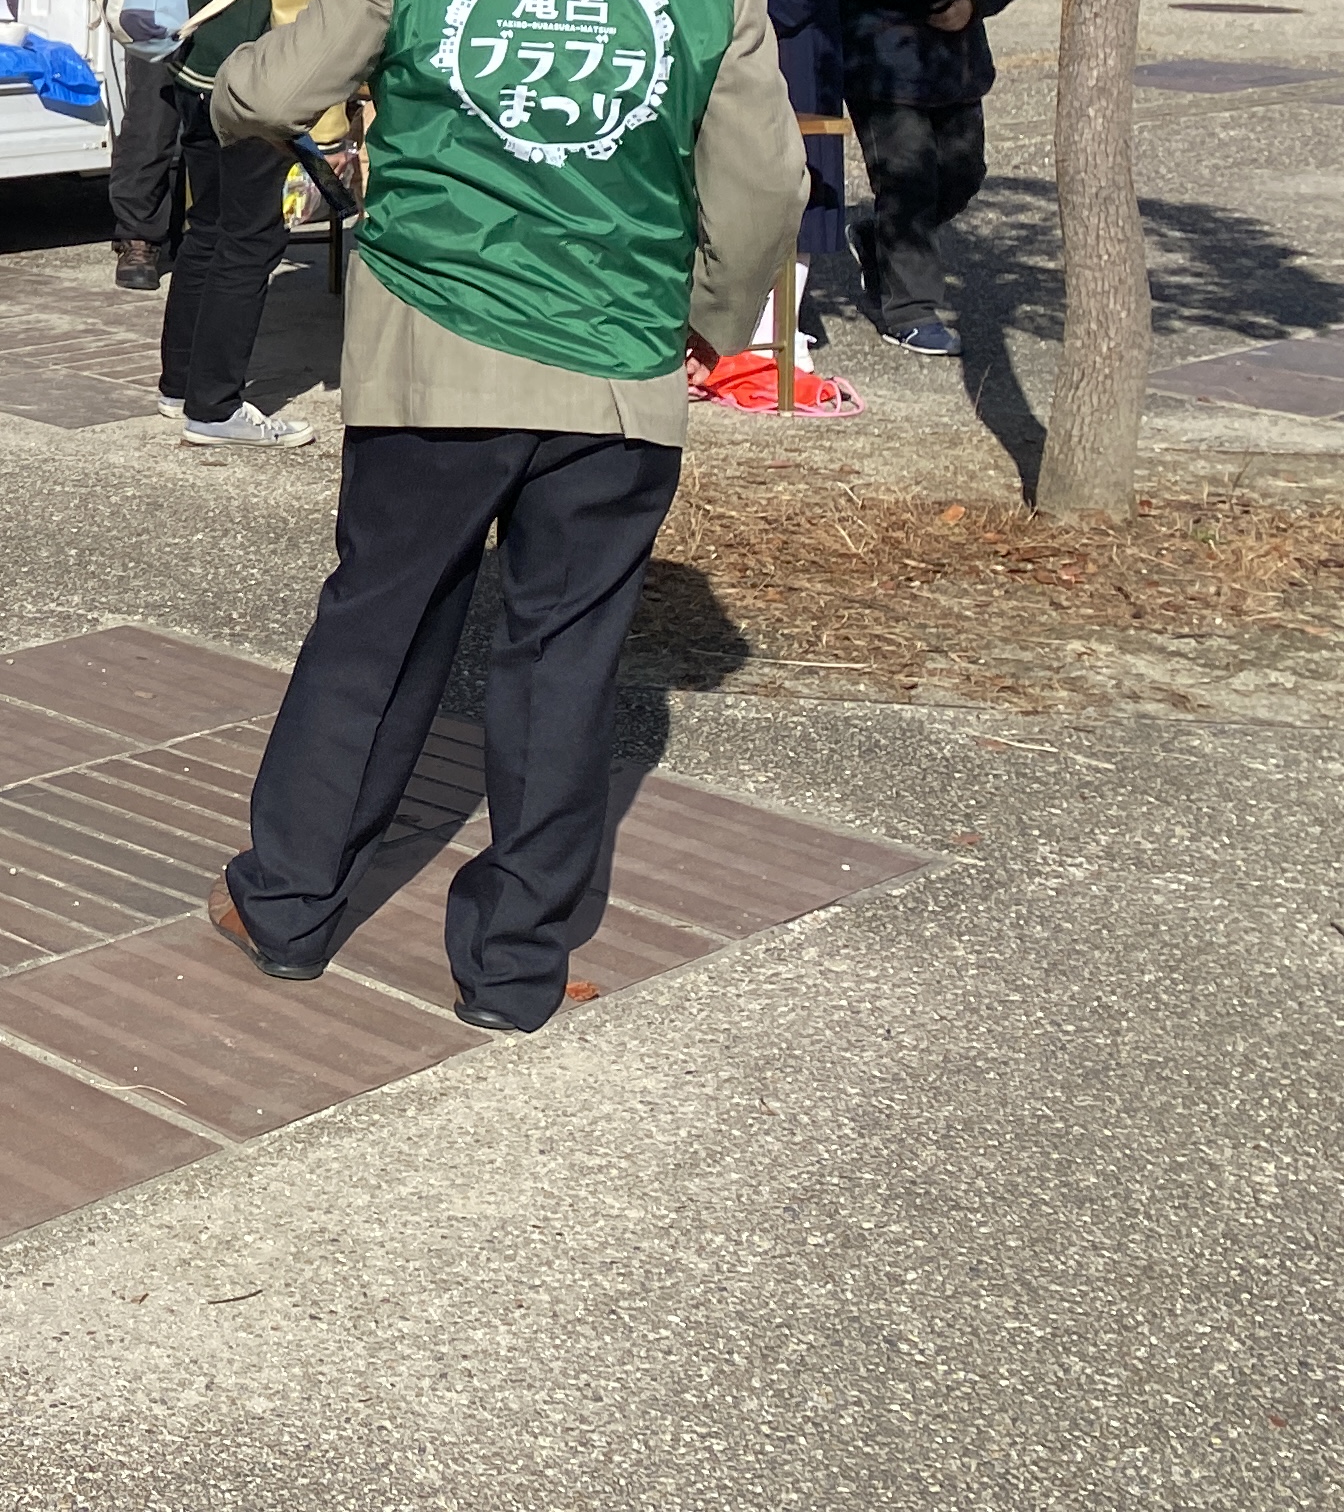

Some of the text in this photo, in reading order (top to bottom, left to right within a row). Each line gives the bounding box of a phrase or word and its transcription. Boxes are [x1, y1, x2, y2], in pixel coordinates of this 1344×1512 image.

[470, 29, 647, 92] ブラブラ
[499, 85, 623, 135] まつり
